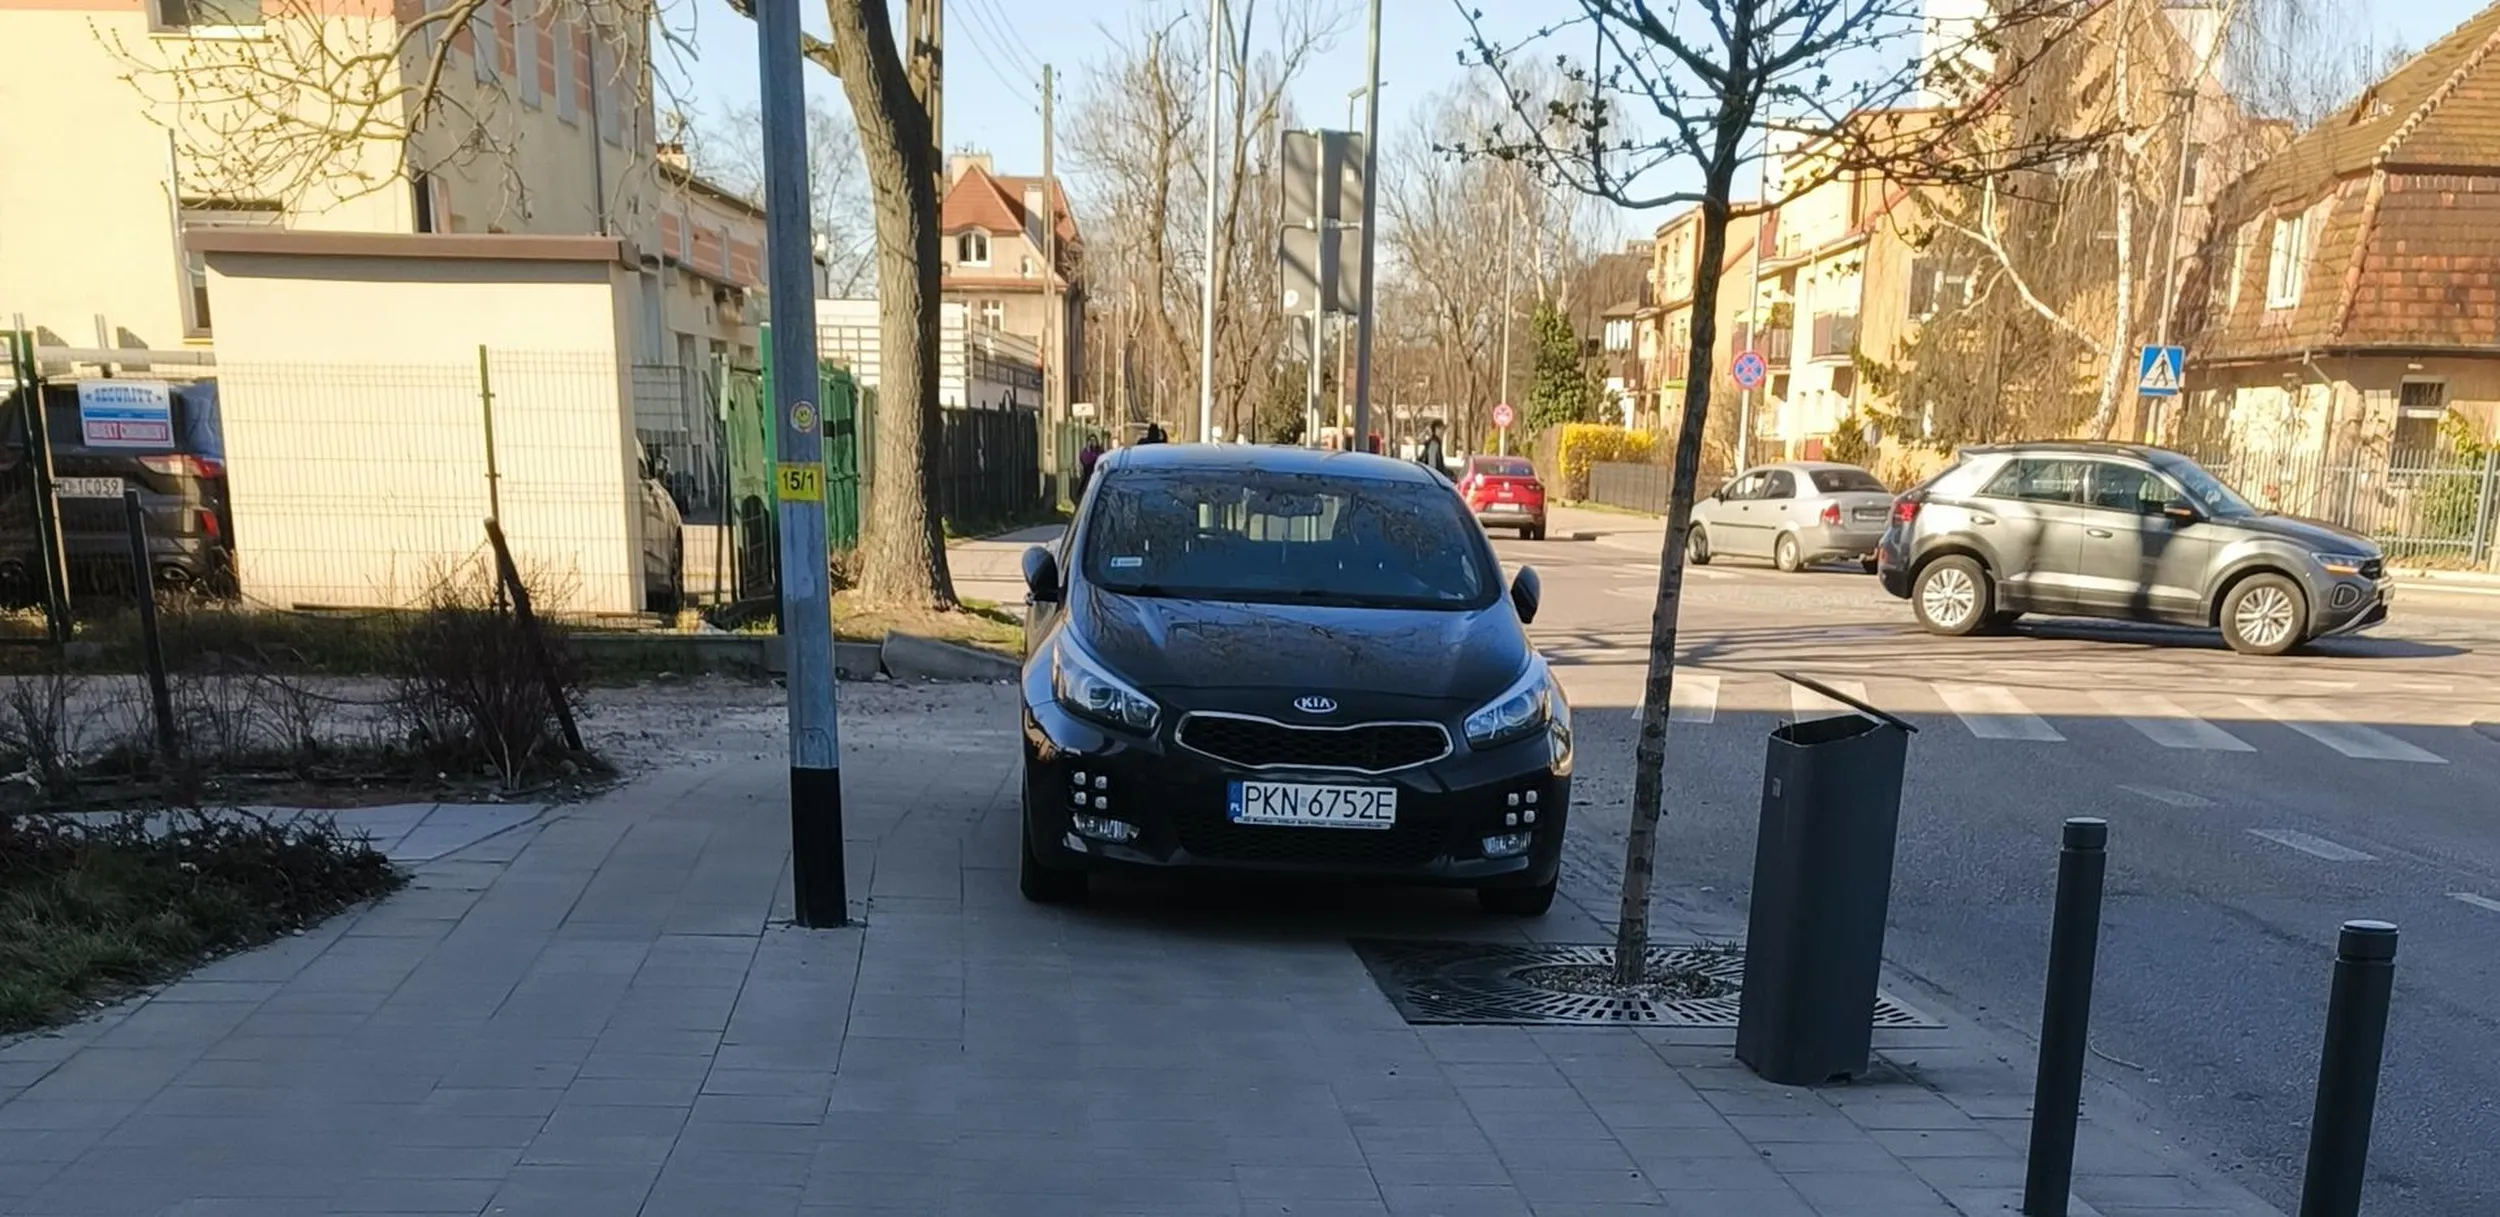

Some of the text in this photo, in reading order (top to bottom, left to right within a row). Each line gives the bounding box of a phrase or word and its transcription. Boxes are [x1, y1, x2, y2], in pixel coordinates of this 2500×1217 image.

[783, 471, 814, 491] 15/1
[1301, 697, 1330, 708] KIA
[1245, 786, 1393, 820] PKN 6752E
